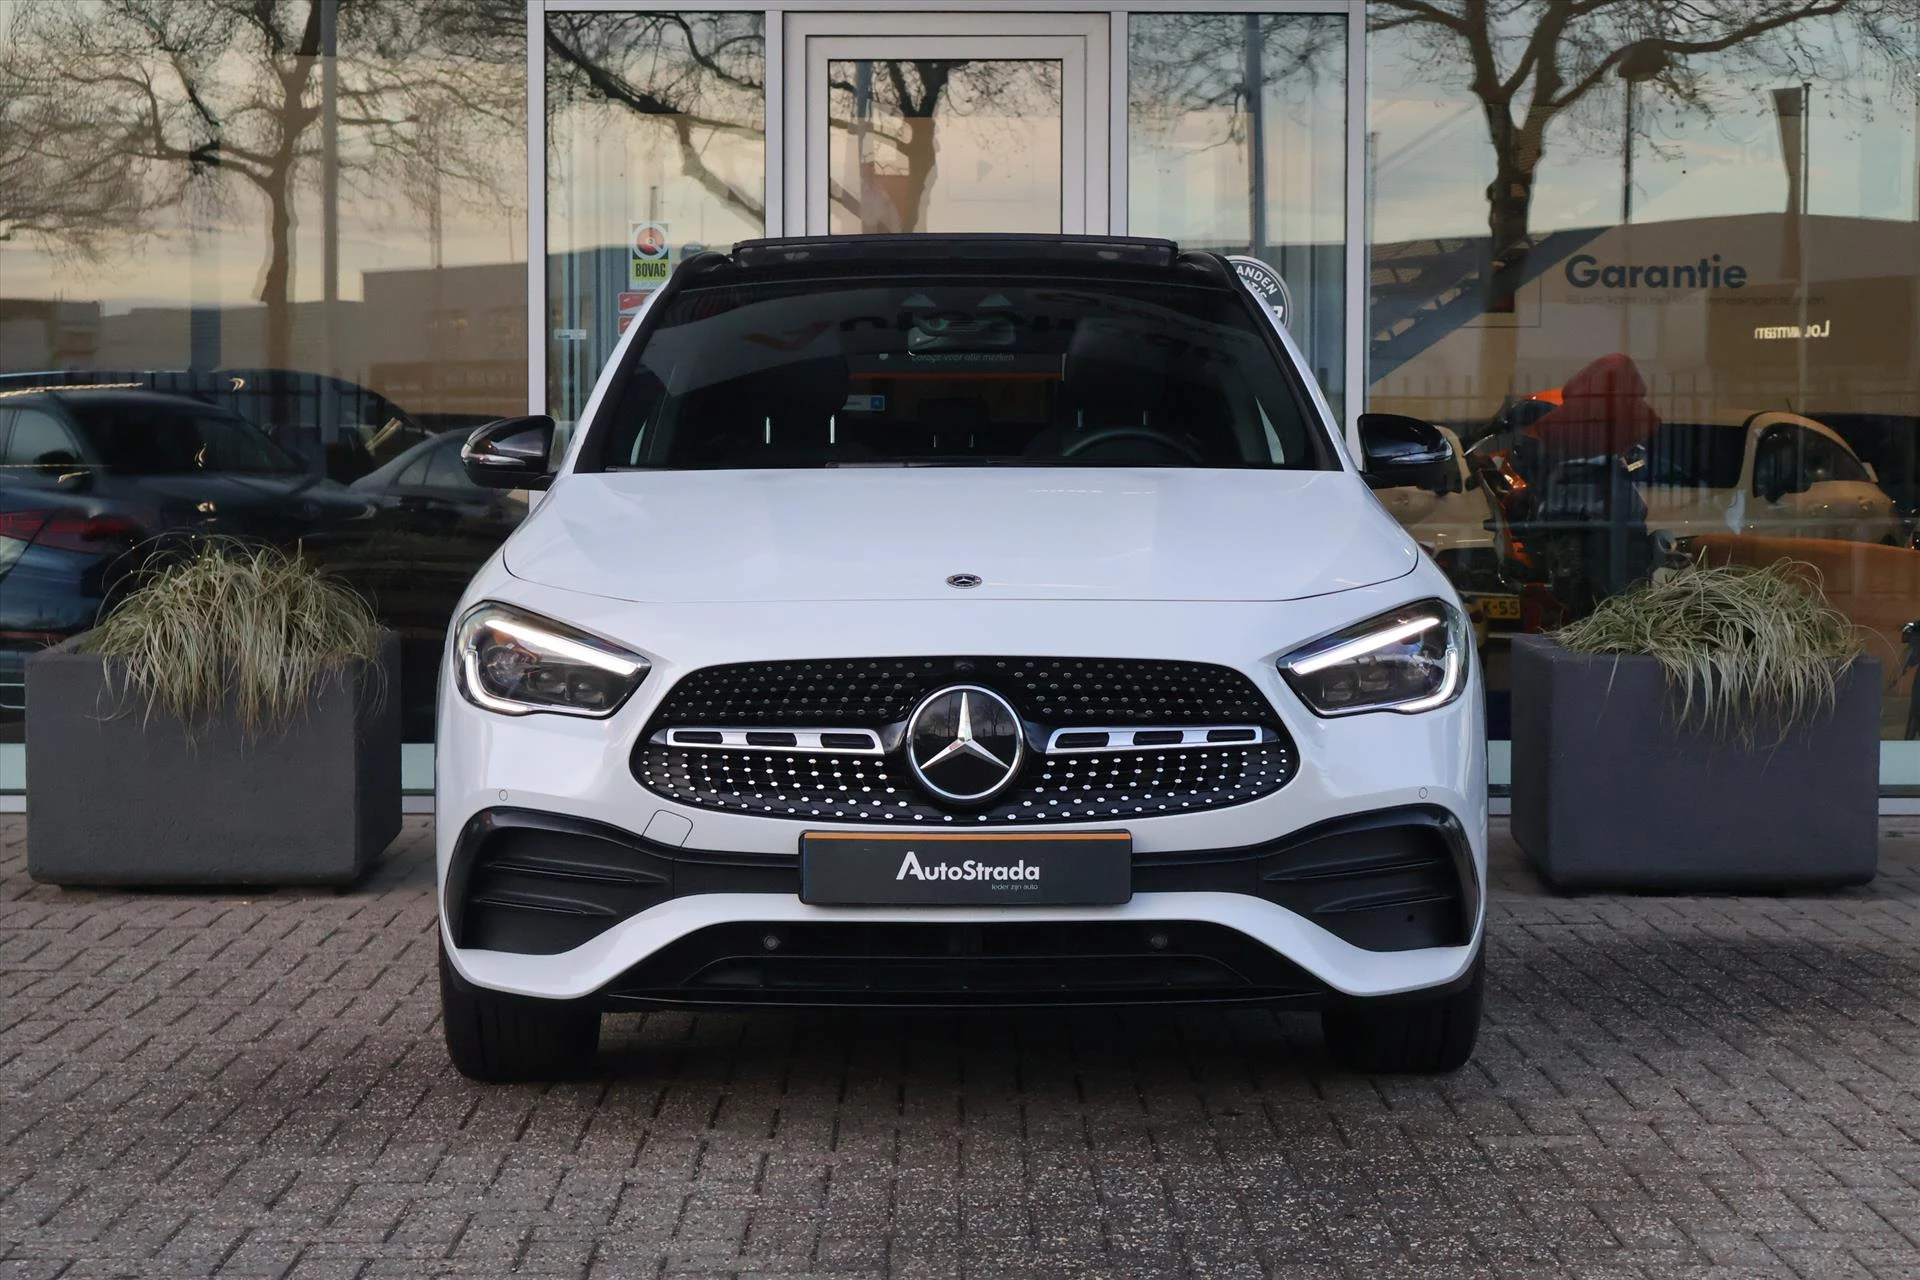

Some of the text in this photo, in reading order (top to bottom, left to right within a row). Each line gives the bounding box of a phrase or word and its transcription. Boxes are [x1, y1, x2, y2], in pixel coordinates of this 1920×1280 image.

[635, 263, 666, 278] BOVAG
[1236, 265, 1278, 295] ANDEN
[1565, 254, 1747, 289] Garantie
[896, 851, 1040, 881] AutoStrada
[1023, 883, 1039, 891] auto
